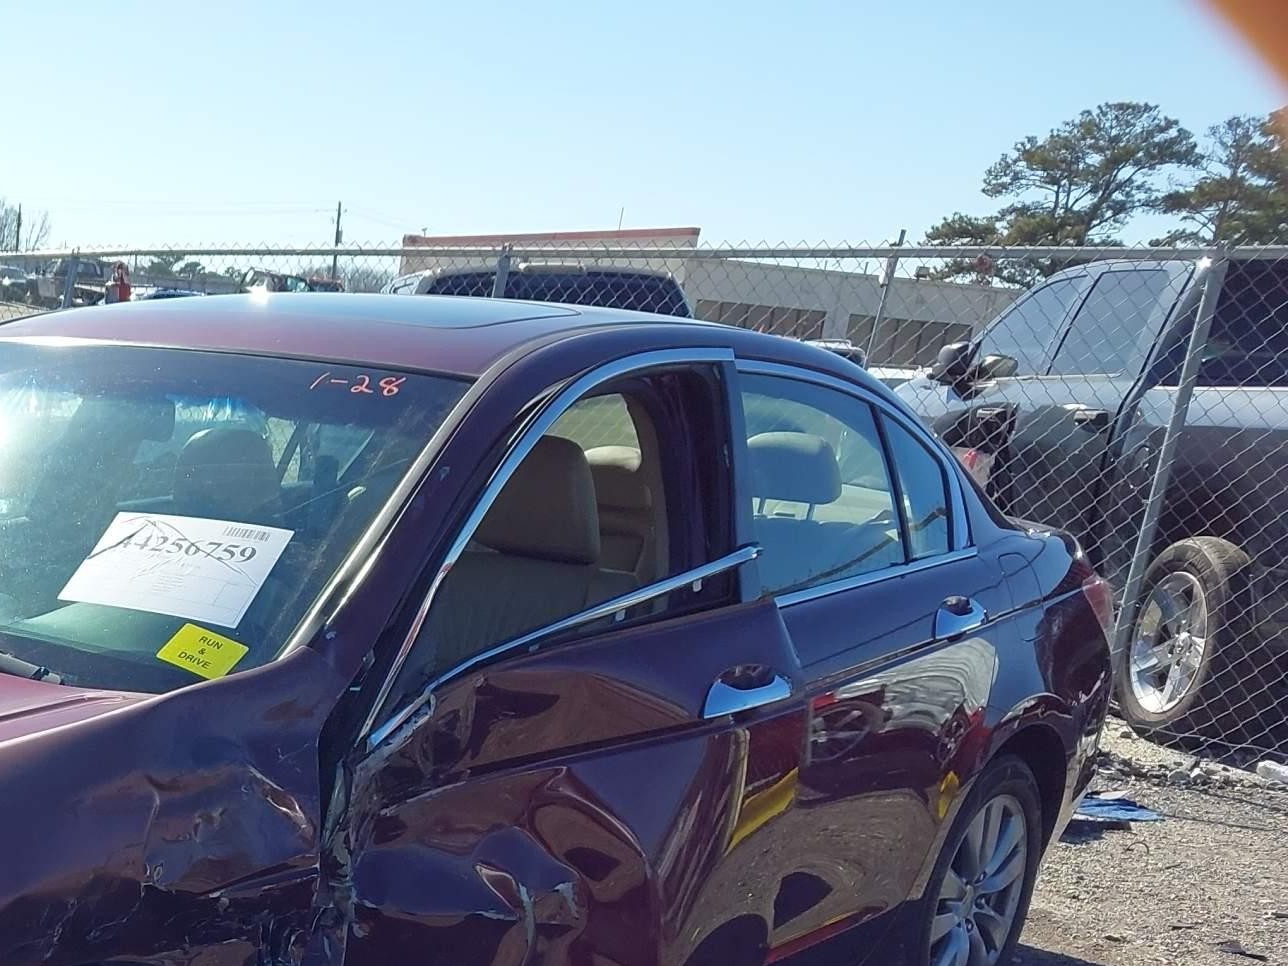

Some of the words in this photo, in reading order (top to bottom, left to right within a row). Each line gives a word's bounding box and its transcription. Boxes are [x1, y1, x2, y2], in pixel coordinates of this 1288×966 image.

[309, 371, 407, 397] 1-28
[198, 635, 223, 650] RUN
[198, 647, 207, 656] &
[178, 651, 212, 669] DRIVE
